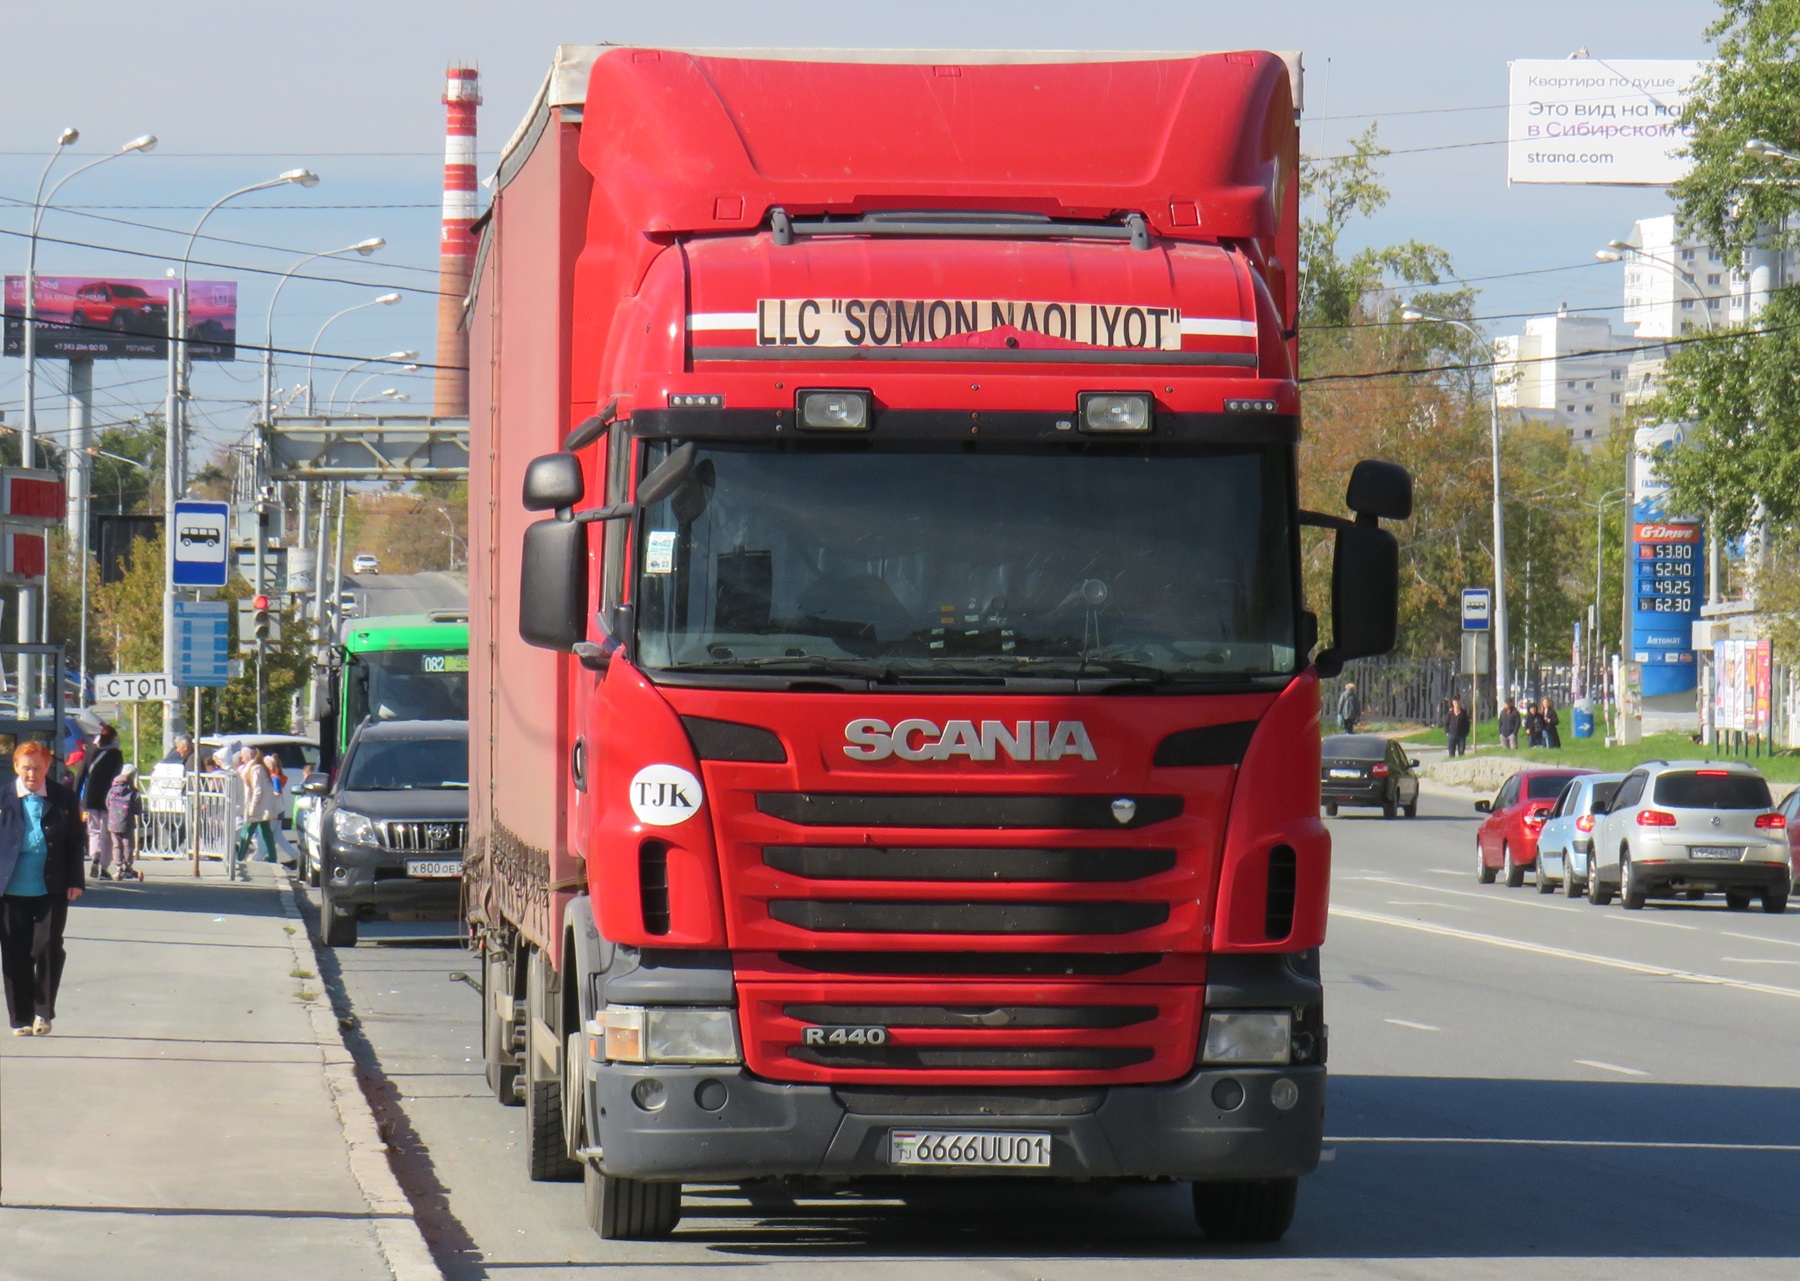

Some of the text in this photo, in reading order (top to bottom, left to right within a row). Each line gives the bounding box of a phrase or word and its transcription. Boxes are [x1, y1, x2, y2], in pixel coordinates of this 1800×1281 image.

[1528, 76, 1675, 89] Квартира по душе
[1528, 101, 1569, 117] Это
[1574, 104, 1616, 119] вид
[1621, 104, 1649, 117] на
[1527, 124, 1541, 137] в
[1546, 121, 1676, 140] Сибирском
[1527, 151, 1614, 164] strana.com
[758, 299, 821, 346] LLC
[832, 299, 978, 346] "SOMON
[1656, 545, 1693, 560] 53.80
[1655, 562, 1692, 577] 52.40
[1655, 580, 1691, 595] 49.25
[1655, 598, 1691, 612] 62.30
[424, 655, 445, 672] 082
[107, 678, 167, 698] СТОП
[843, 718, 1098, 761] SCANIA
[635, 782, 694, 808] TJK
[806, 1028, 886, 1045] R 440
[916, 1134, 1045, 1164] 6666UU01
